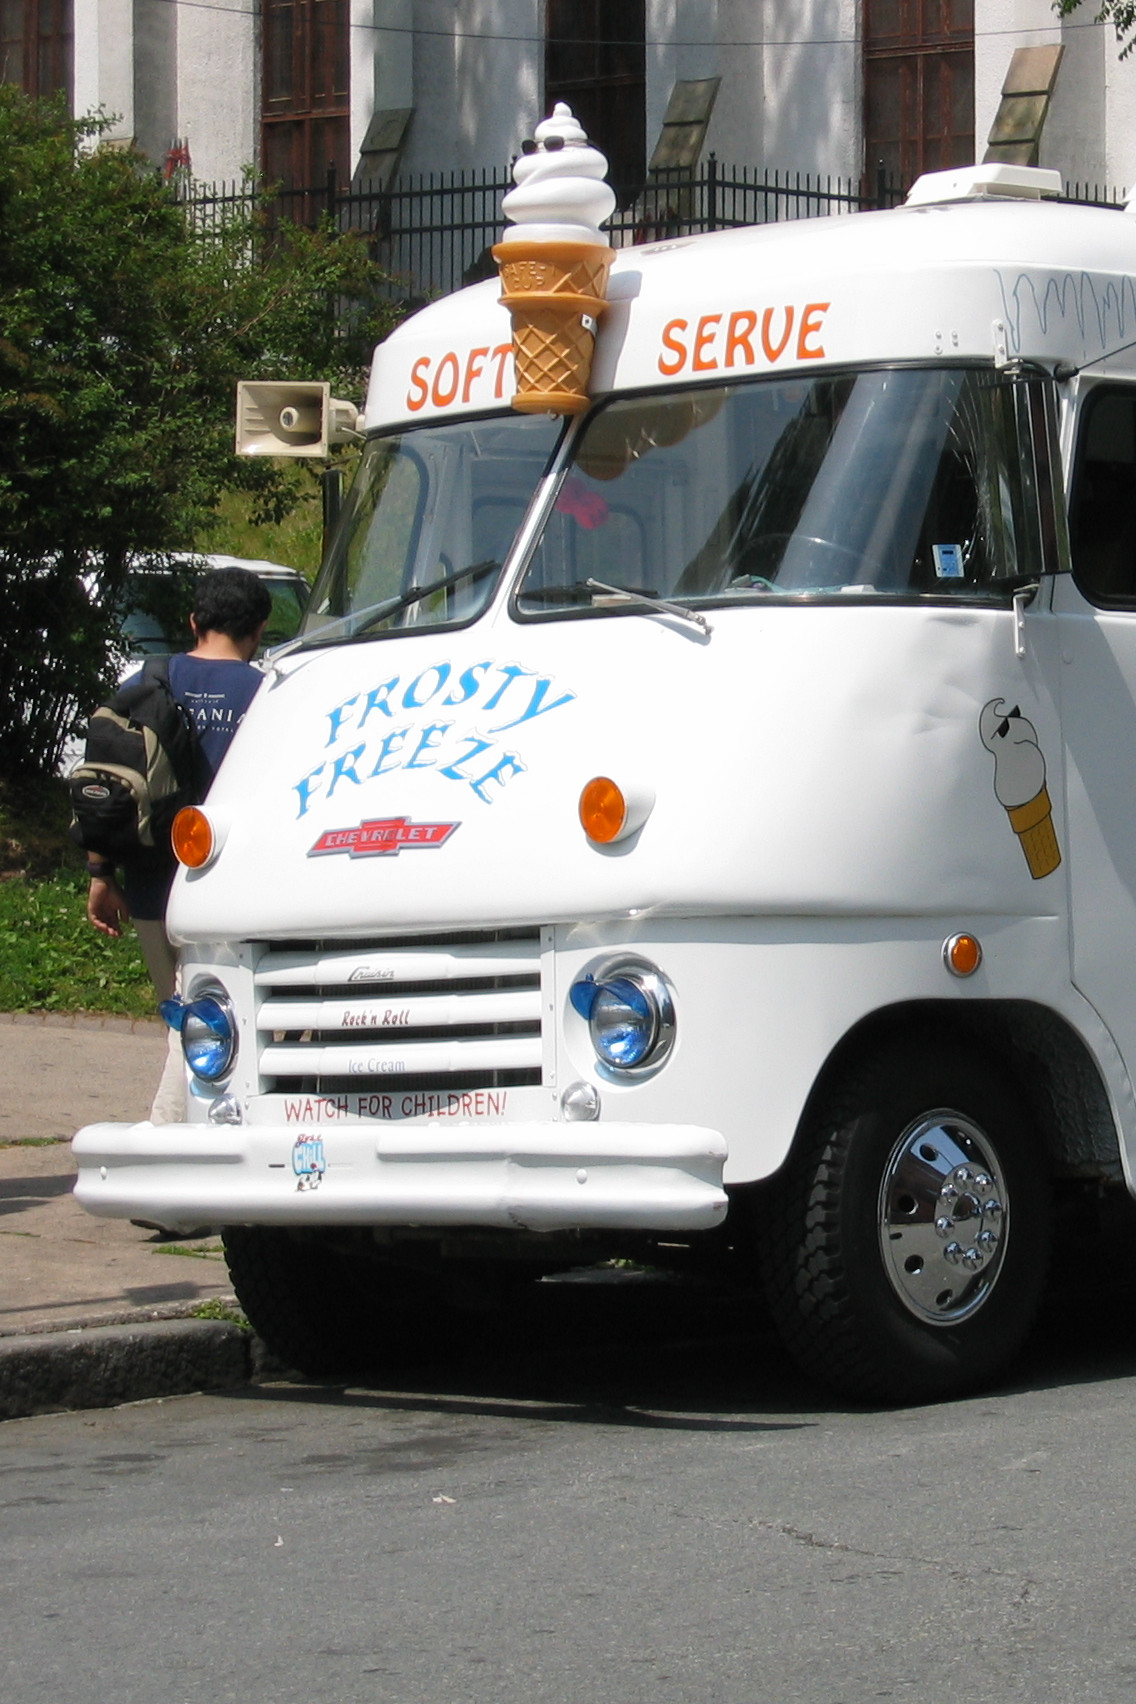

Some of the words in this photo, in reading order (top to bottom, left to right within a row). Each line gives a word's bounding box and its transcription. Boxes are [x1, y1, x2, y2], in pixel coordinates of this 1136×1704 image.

[406, 343, 515, 412] SOFT
[657, 302, 832, 377] SERVE
[324, 659, 578, 749] FROSTY
[292, 719, 528, 821] FREEZE
[381, 1009, 411, 1027] Roll
[348, 1058, 364, 1074] Ice
[367, 1056, 406, 1073] Cream
[284, 1095, 349, 1123] WATCH
[358, 1096, 393, 1120] FOR
[400, 1091, 508, 1118] CHILDREN!
